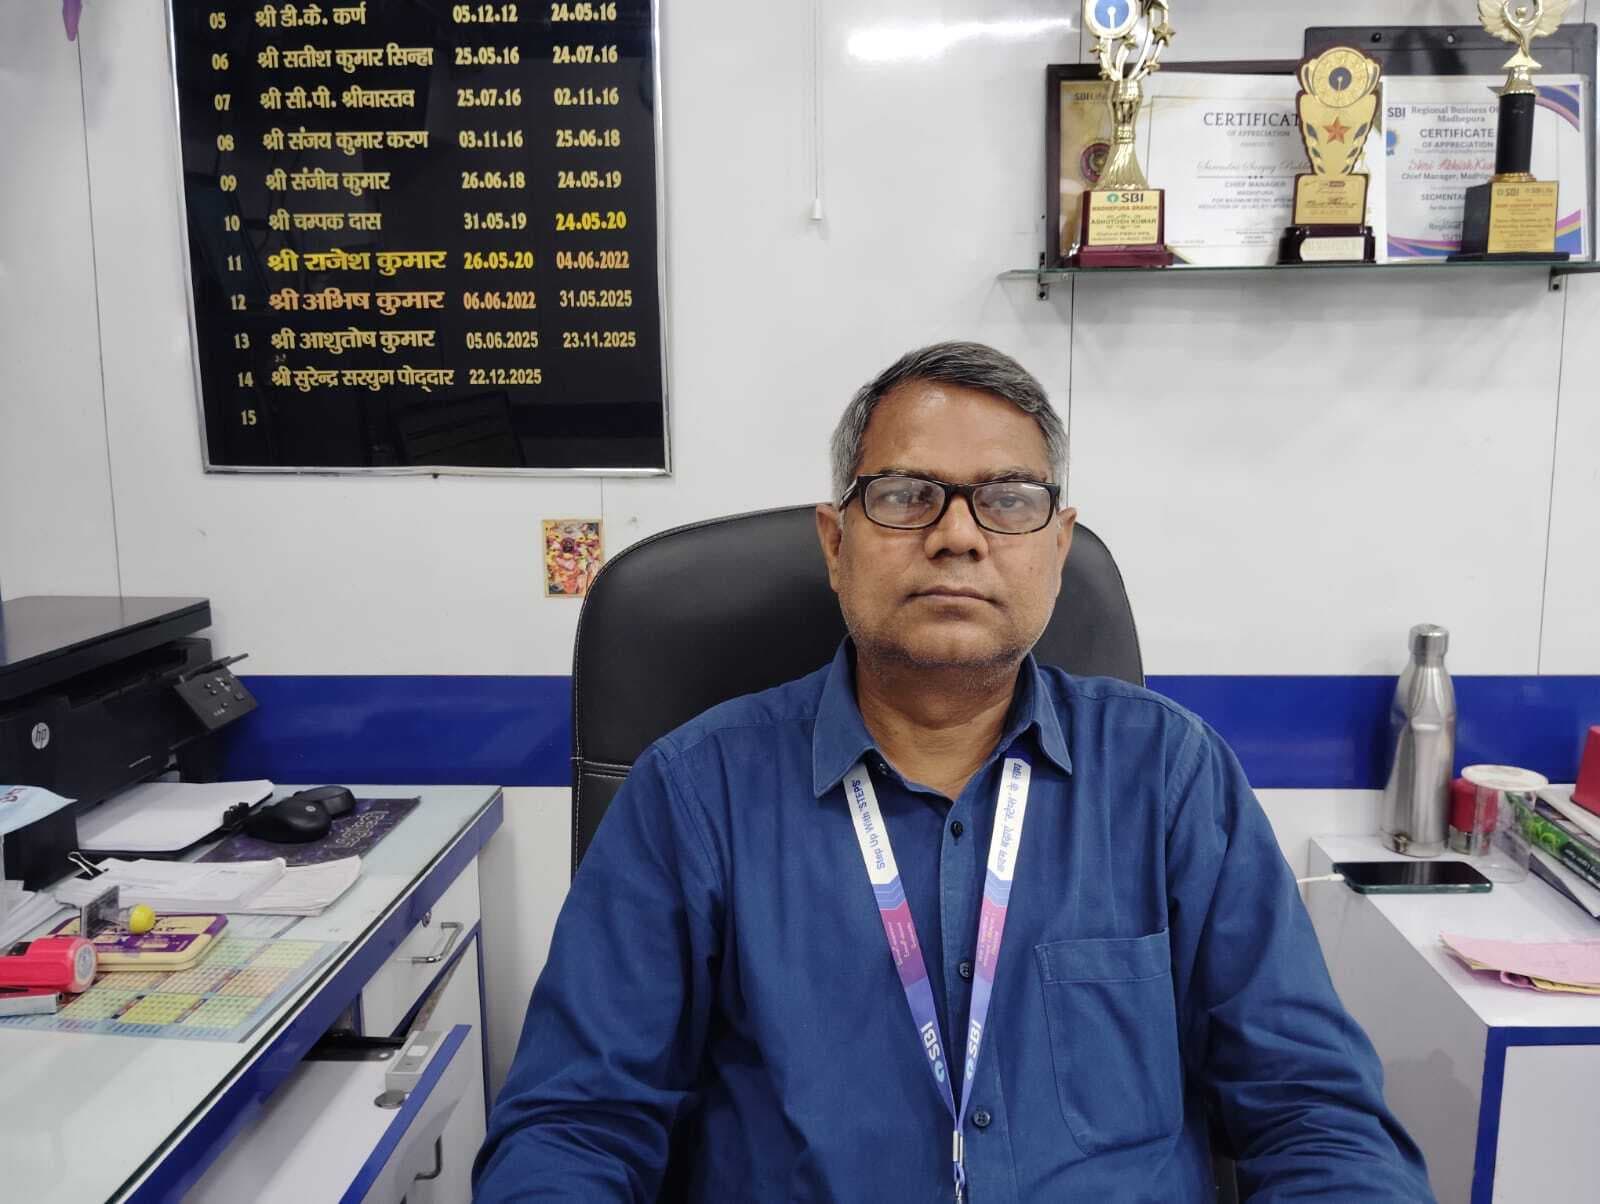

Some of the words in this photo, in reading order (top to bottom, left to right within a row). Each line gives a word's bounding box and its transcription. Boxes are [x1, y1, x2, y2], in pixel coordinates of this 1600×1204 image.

[210, 13, 226, 29] 05
[256, 5, 276, 27] श्री
[280, 4, 328, 27] डी.के.
[333, 2, 366, 25] कर्ण
[453, 4, 518, 23] 05.12.12
[552, 3, 616, 21] 24.05.16
[212, 54, 228, 69] 06
[258, 46, 279, 68] श्री
[283, 45, 331, 67] सतीश
[336, 49, 384, 73] कुमार
[386, 43, 433, 66] सिन्हा
[456, 47, 519, 64] 25.05.16
[553, 45, 617, 63] 24.07.16
[215, 95, 230, 110] 07
[261, 87, 281, 109] श्री
[286, 86, 336, 108] सी.पी.
[342, 85, 415, 107] श्रीवास्तव
[457, 88, 521, 106] 25.07.16
[554, 88, 619, 105] 02.11.16
[1411, 106, 1448, 114] Regional
[1450, 106, 1487, 114] Business
[1203, 112, 1299, 127] CERTIFICAT
[1387, 107, 1406, 118] SBI
[217, 135, 234, 150] 08
[263, 128, 284, 149] श्री
[288, 127, 332, 149] संजय
[336, 132, 384, 155] कुमार
[386, 131, 428, 148] करण
[459, 130, 523, 148] 03.11.16
[556, 129, 620, 147] 25.06.18
[1420, 129, 1495, 138] CERTIFICATE
[221, 175, 236, 191] 09
[266, 169, 287, 190] श्री
[291, 168, 338, 190] संजीव
[342, 173, 390, 196] कुमार
[462, 172, 525, 188] 26.06.18
[558, 171, 621, 188] 24.05.19
[1121, 193, 1144, 202] SBI
[225, 216, 240, 231] 10
[269, 209, 290, 230] श्री
[293, 214, 344, 230] चम्पक
[348, 213, 381, 230] दास
[464, 213, 526, 229] 31.05.19
[556, 211, 626, 230] 24.05.20
[228, 256, 241, 270] 11
[268, 249, 299, 271] श्री
[304, 249, 370, 270] राजेश
[376, 252, 447, 275] कुमार
[464, 252, 533, 269] 26.05.20
[557, 251, 629, 269] 04.06.2022
[232, 295, 246, 309] 12
[269, 288, 299, 310] श्री
[303, 288, 370, 310] अभिष
[376, 292, 445, 315] कुमार
[464, 291, 536, 309] 06.06.2022
[560, 290, 632, 307] 31.05.2025
[235, 334, 249, 348] 13
[272, 328, 295, 349] श्री
[300, 327, 376, 354] आशुतोष
[380, 331, 435, 353] कुमार
[467, 332, 538, 349] 05.06.2025
[563, 332, 636, 348] 23.11.2025
[239, 372, 253, 386] 14
[272, 366, 291, 386] श्री
[293, 367, 338, 392] सुरेन्द्र
[470, 369, 541, 384] 22.12.2025
[242, 411, 256, 424] 15
[862, 812, 875, 833] With
[870, 833, 880, 848] Up
[874, 848, 886, 870] Step
[921, 1021, 941, 1061] SBI
[969, 1019, 981, 1055] SBI
